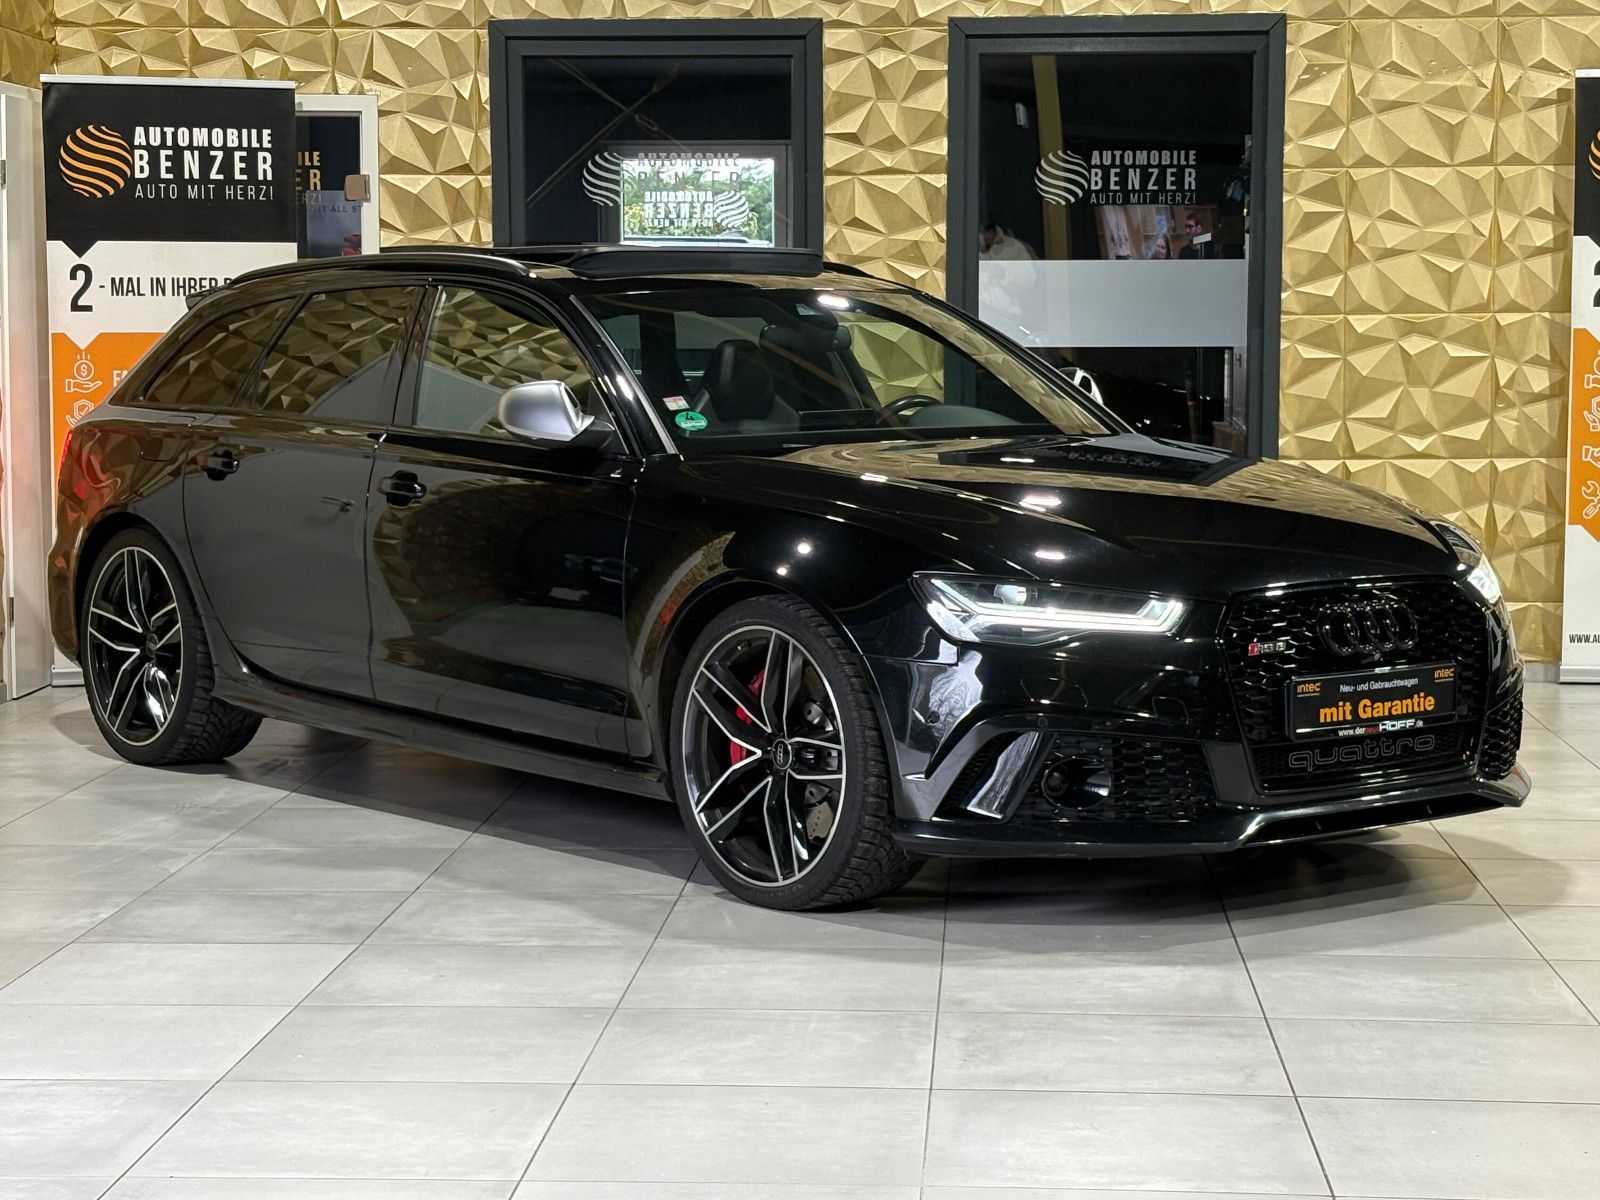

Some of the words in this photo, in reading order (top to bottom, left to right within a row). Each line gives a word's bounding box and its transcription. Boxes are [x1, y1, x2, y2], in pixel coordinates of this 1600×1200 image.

[133, 126, 272, 148] AUTOMOBILE
[133, 149, 273, 181] BENZER
[1090, 150, 1197, 166] AUTOMOBILE
[1090, 168, 1197, 190] BENZER
[135, 183, 178, 199] AUTO
[187, 184, 216, 200] MIT
[1090, 192, 1123, 205] AUTO
[1129, 192, 1152, 204] MIT
[69, 263, 93, 312] 2
[111, 277, 146, 297] MAL
[151, 277, 166, 297] IN
[1339, 683, 1356, 693] Neu-
[1356, 681, 1369, 691] und
[1319, 701, 1352, 723] mit
[1358, 692, 1435, 719] Garantie
[1289, 734, 1435, 771] quattro
